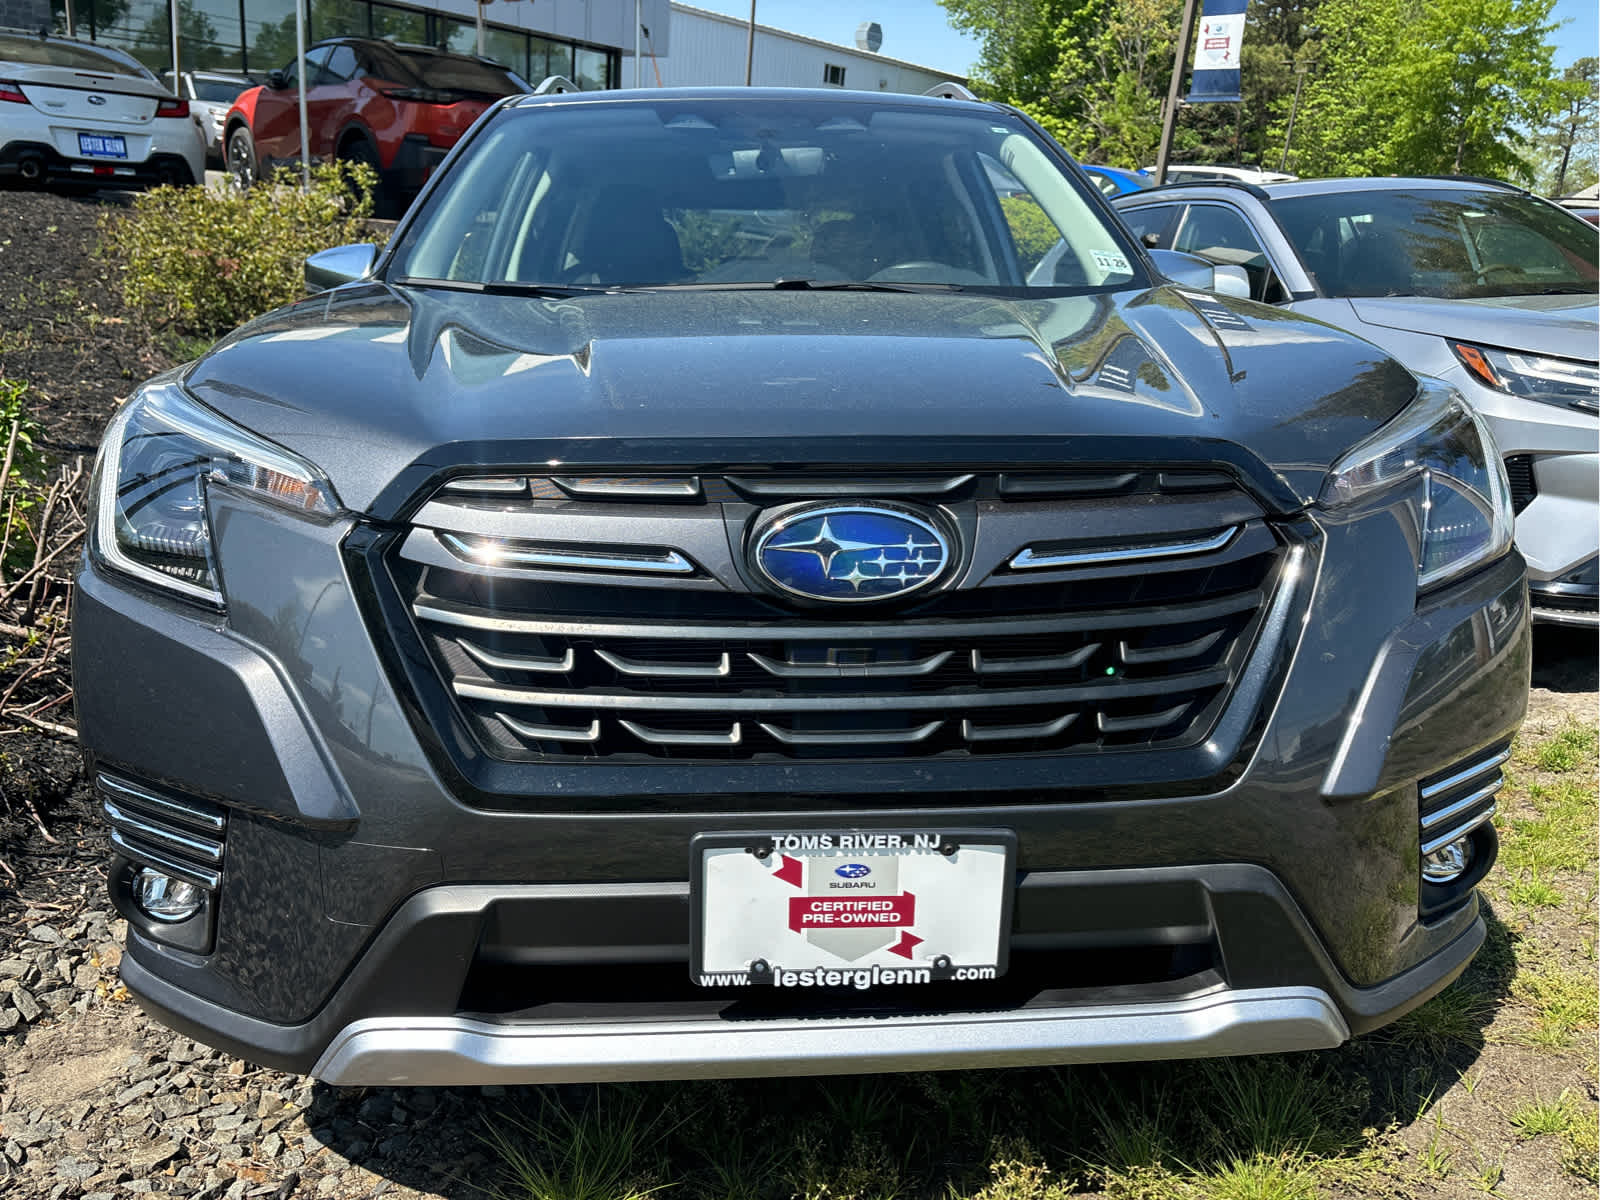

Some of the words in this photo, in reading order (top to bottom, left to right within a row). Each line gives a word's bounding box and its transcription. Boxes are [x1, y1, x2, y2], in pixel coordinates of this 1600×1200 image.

[771, 835, 833, 850] TOMS
[839, 834, 908, 850] RIVER,
[914, 834, 941, 849] NJ
[810, 901, 894, 912] CERTIFIED
[802, 912, 901, 924] PRE-OWNED
[700, 973, 751, 987] www.
[773, 965, 930, 990] lesterglenn
[950, 966, 997, 981] .com
